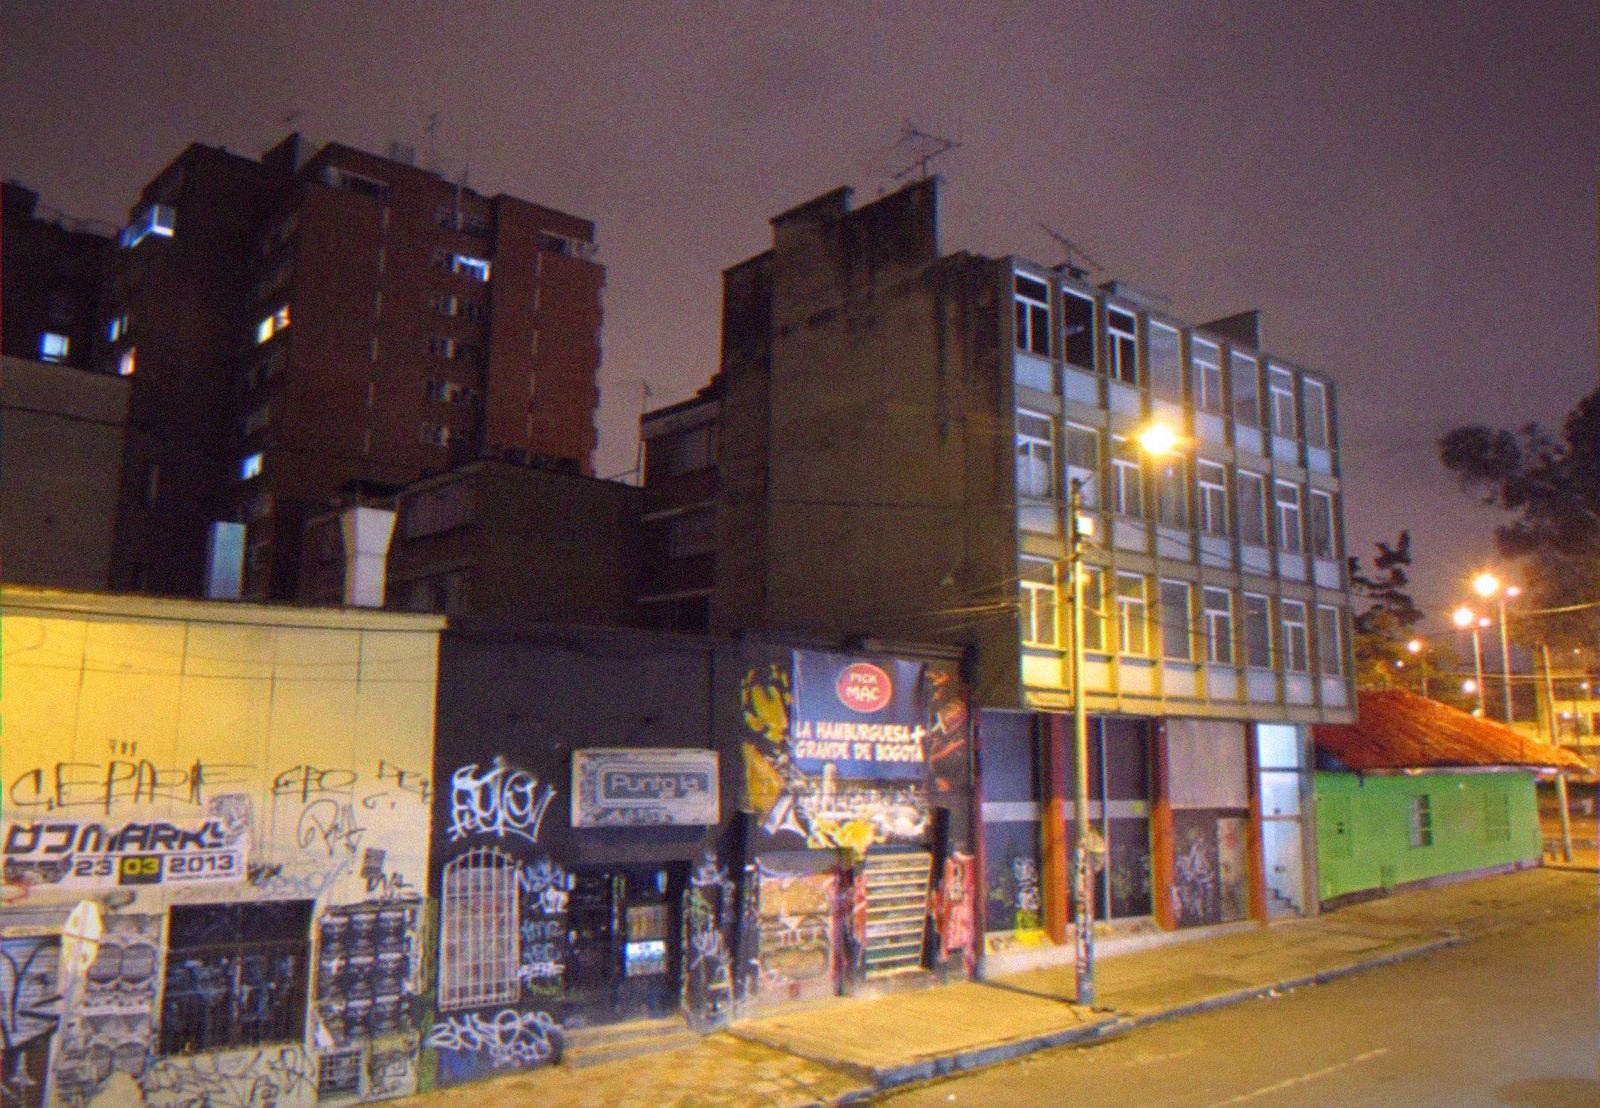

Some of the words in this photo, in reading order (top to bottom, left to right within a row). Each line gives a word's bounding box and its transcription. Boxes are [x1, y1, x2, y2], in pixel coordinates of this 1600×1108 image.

[845, 685, 881, 703] MAC
[796, 720, 812, 738] LA
[816, 720, 910, 742] HAMBURGUESA
[795, 740, 849, 760] GRANDE
[852, 742, 872, 761] DE
[75, 859, 113, 876] 23
[122, 857, 162, 875] 03
[169, 854, 235, 873] 2013
